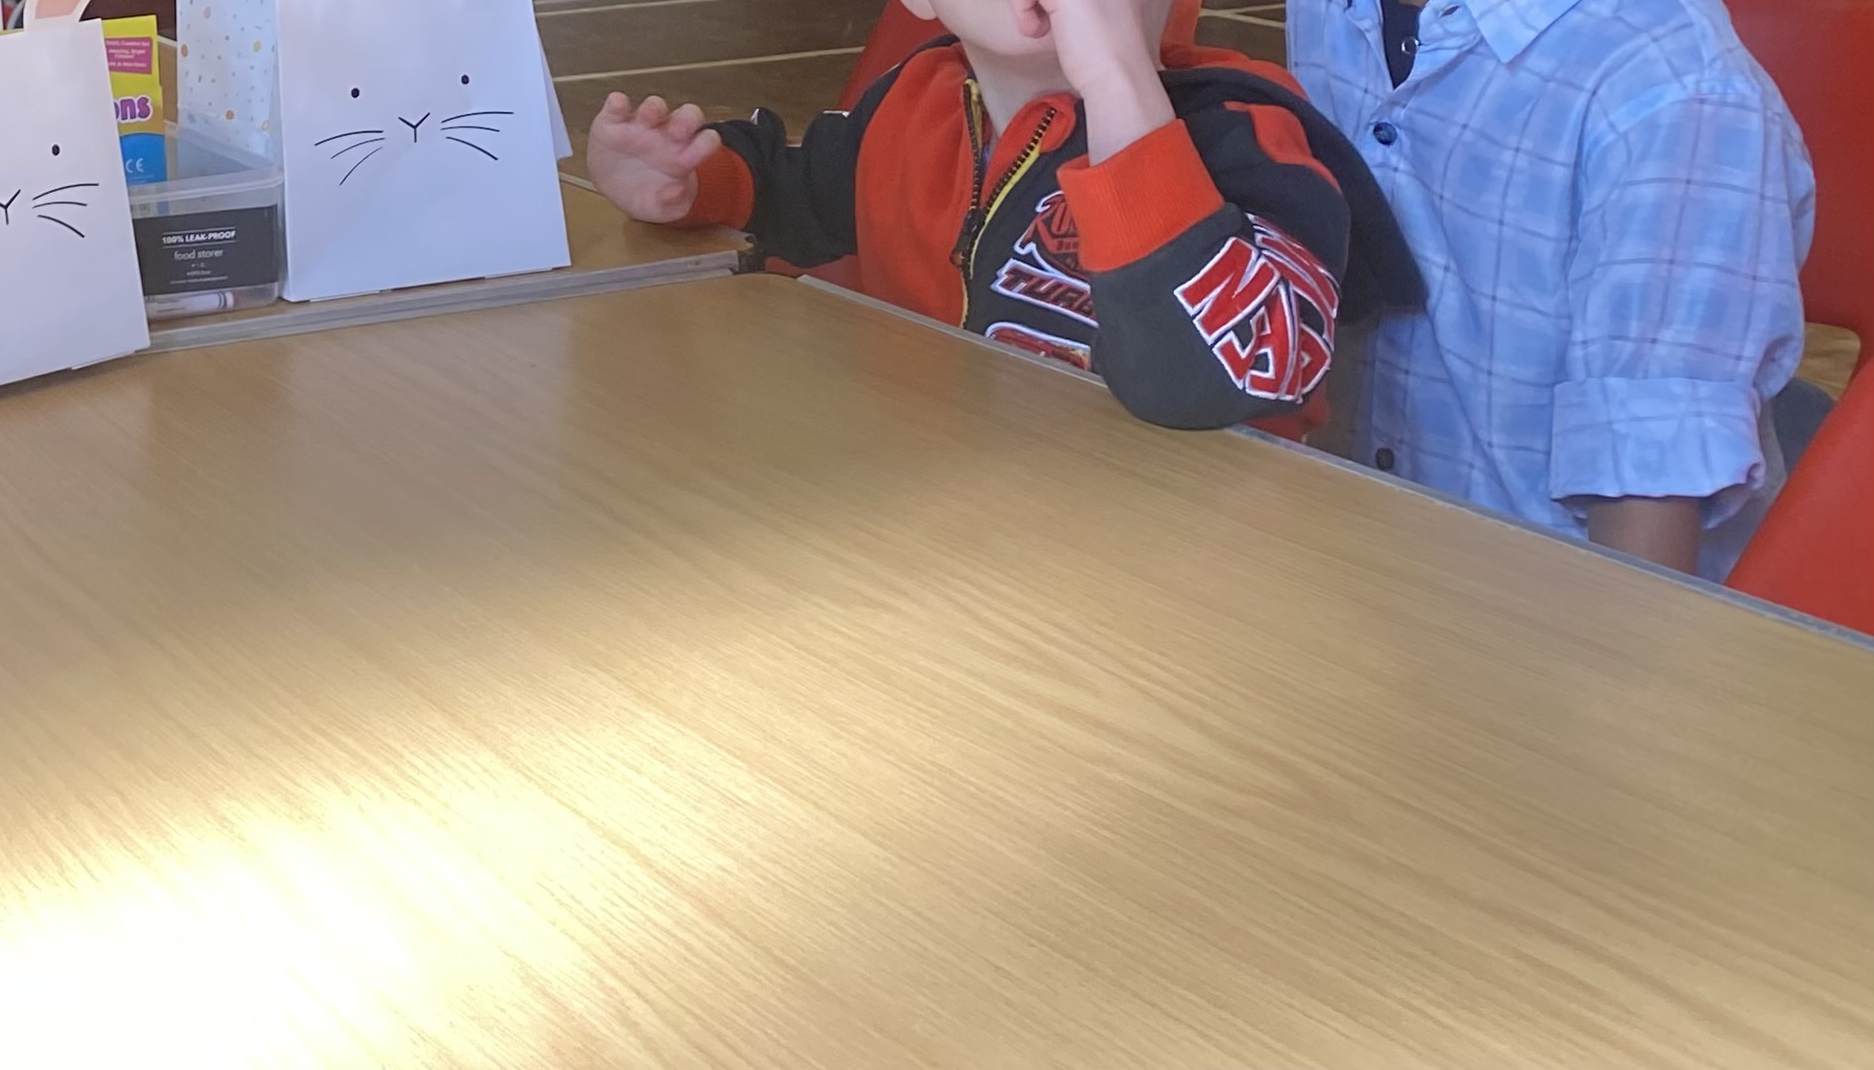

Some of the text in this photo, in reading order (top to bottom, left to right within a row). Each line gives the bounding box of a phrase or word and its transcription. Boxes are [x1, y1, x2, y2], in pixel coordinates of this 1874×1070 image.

[185, 230, 237, 244] LEAK-PROOF
[173, 247, 224, 261] food storer
